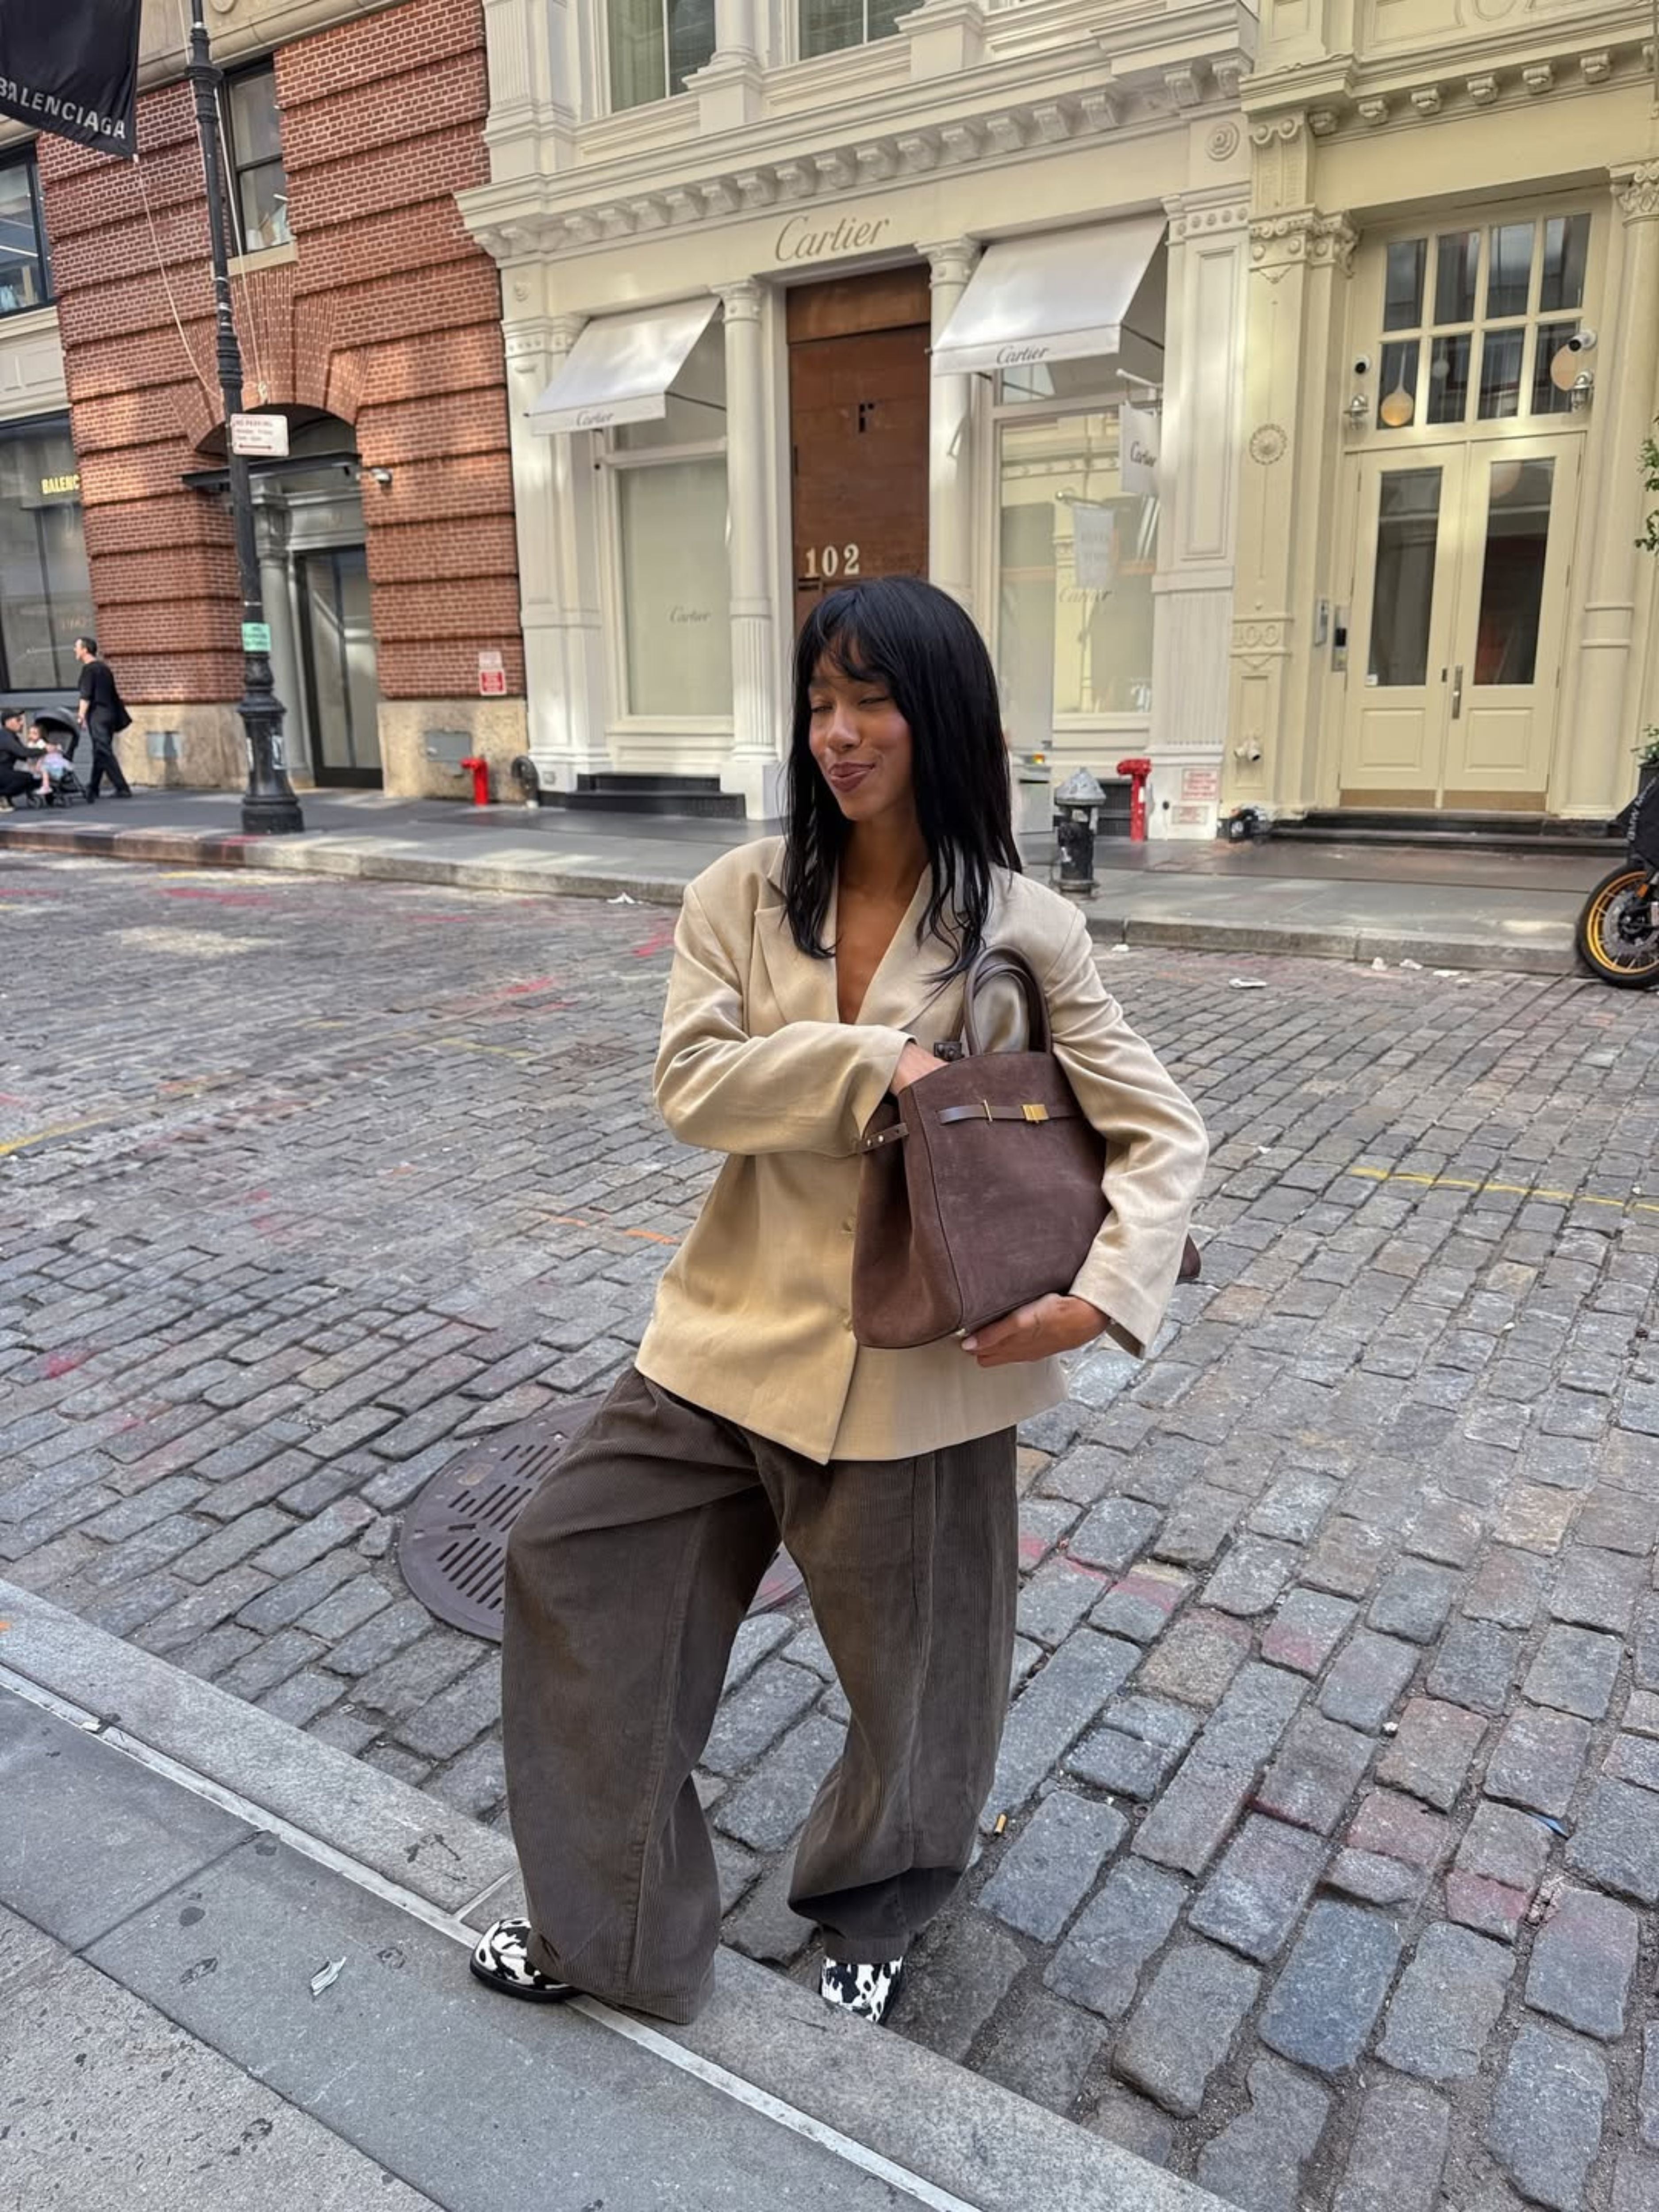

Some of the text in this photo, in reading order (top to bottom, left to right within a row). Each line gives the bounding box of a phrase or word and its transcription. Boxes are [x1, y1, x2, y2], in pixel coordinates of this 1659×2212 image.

[0, 76, 126, 139] BALENCIAGA
[775, 215, 890, 261] Cartier
[996, 345, 1050, 364] Cartier
[576, 409, 614, 426] Cartier
[1130, 441, 1157, 468] Cartier
[804, 544, 860, 579] 102
[670, 605, 712, 623] Cartier
